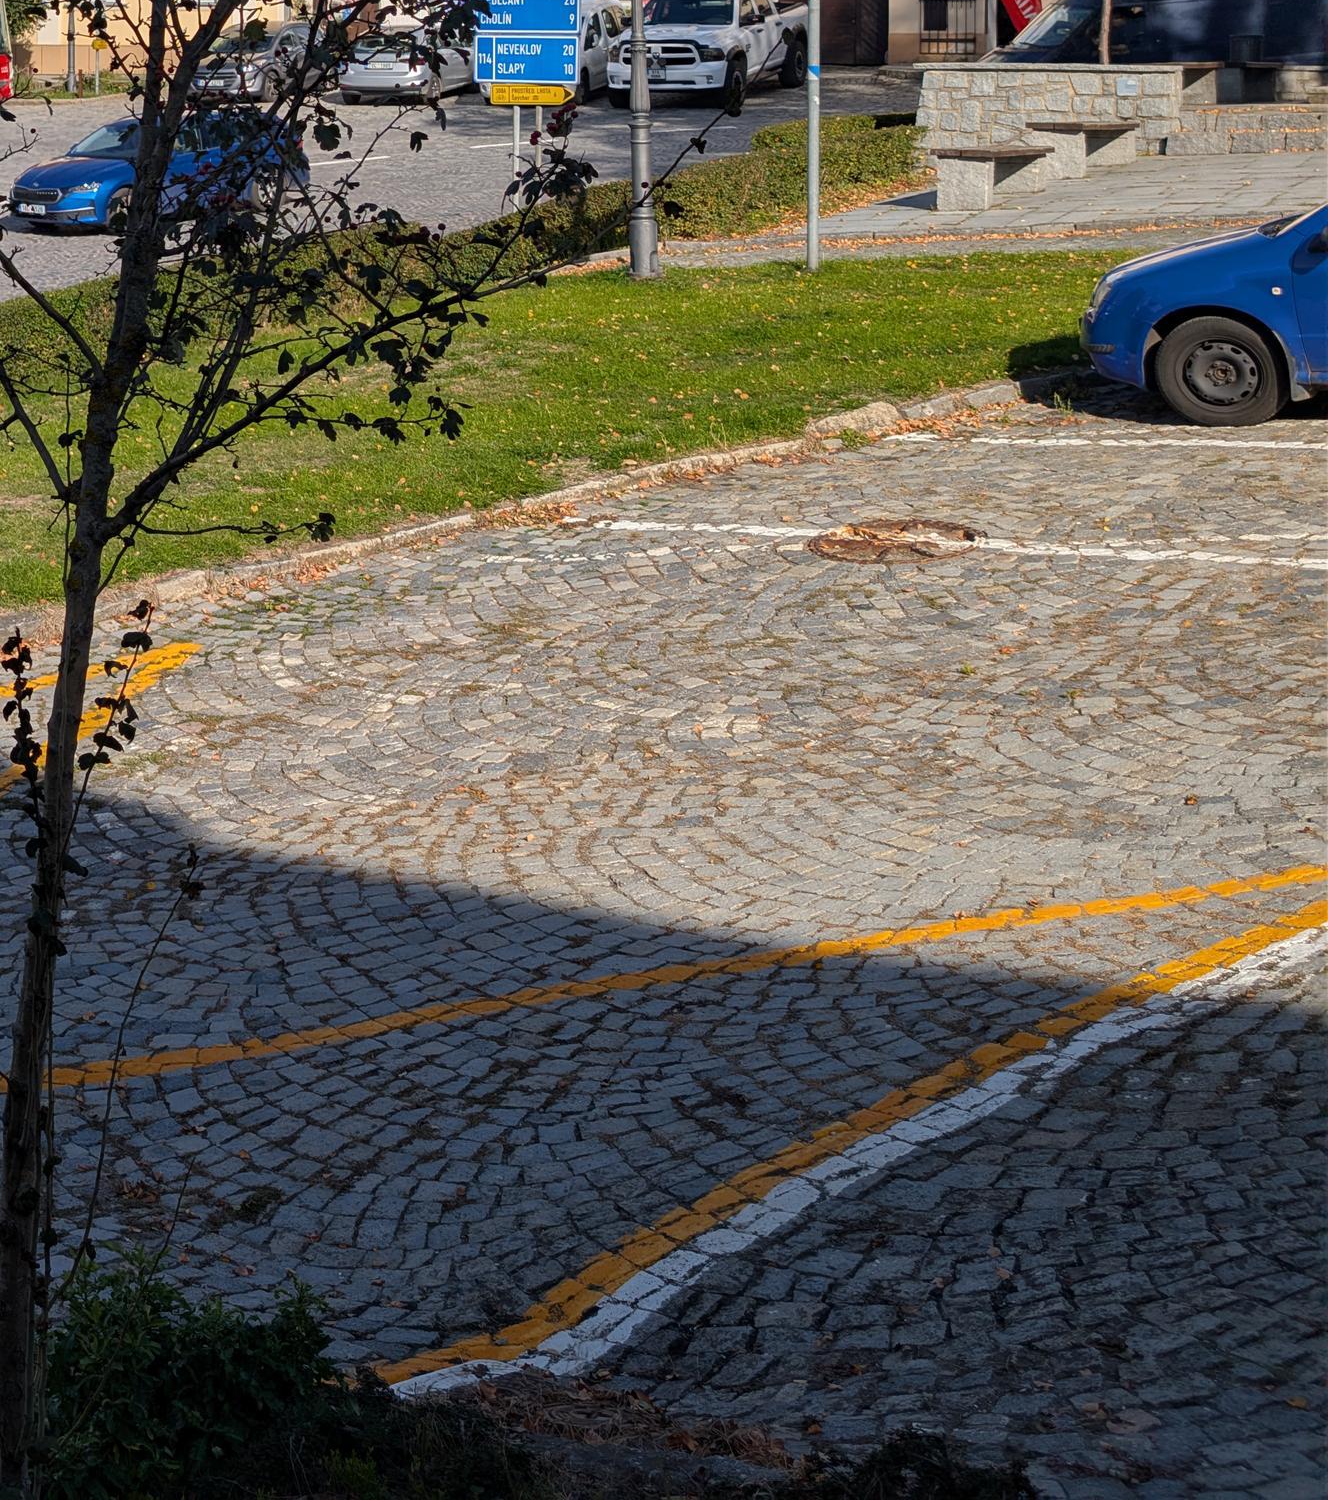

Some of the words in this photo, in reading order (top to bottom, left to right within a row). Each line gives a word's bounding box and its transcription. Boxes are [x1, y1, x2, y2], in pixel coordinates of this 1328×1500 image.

[480, 11, 512, 25] CHOLÍN
[569, 13, 575, 25] 9
[497, 44, 542, 55] NEVEKLOV
[563, 45, 575, 56] 20
[478, 53, 492, 64] 114
[497, 63, 526, 74] SLAPY
[563, 63, 574, 75] 10
